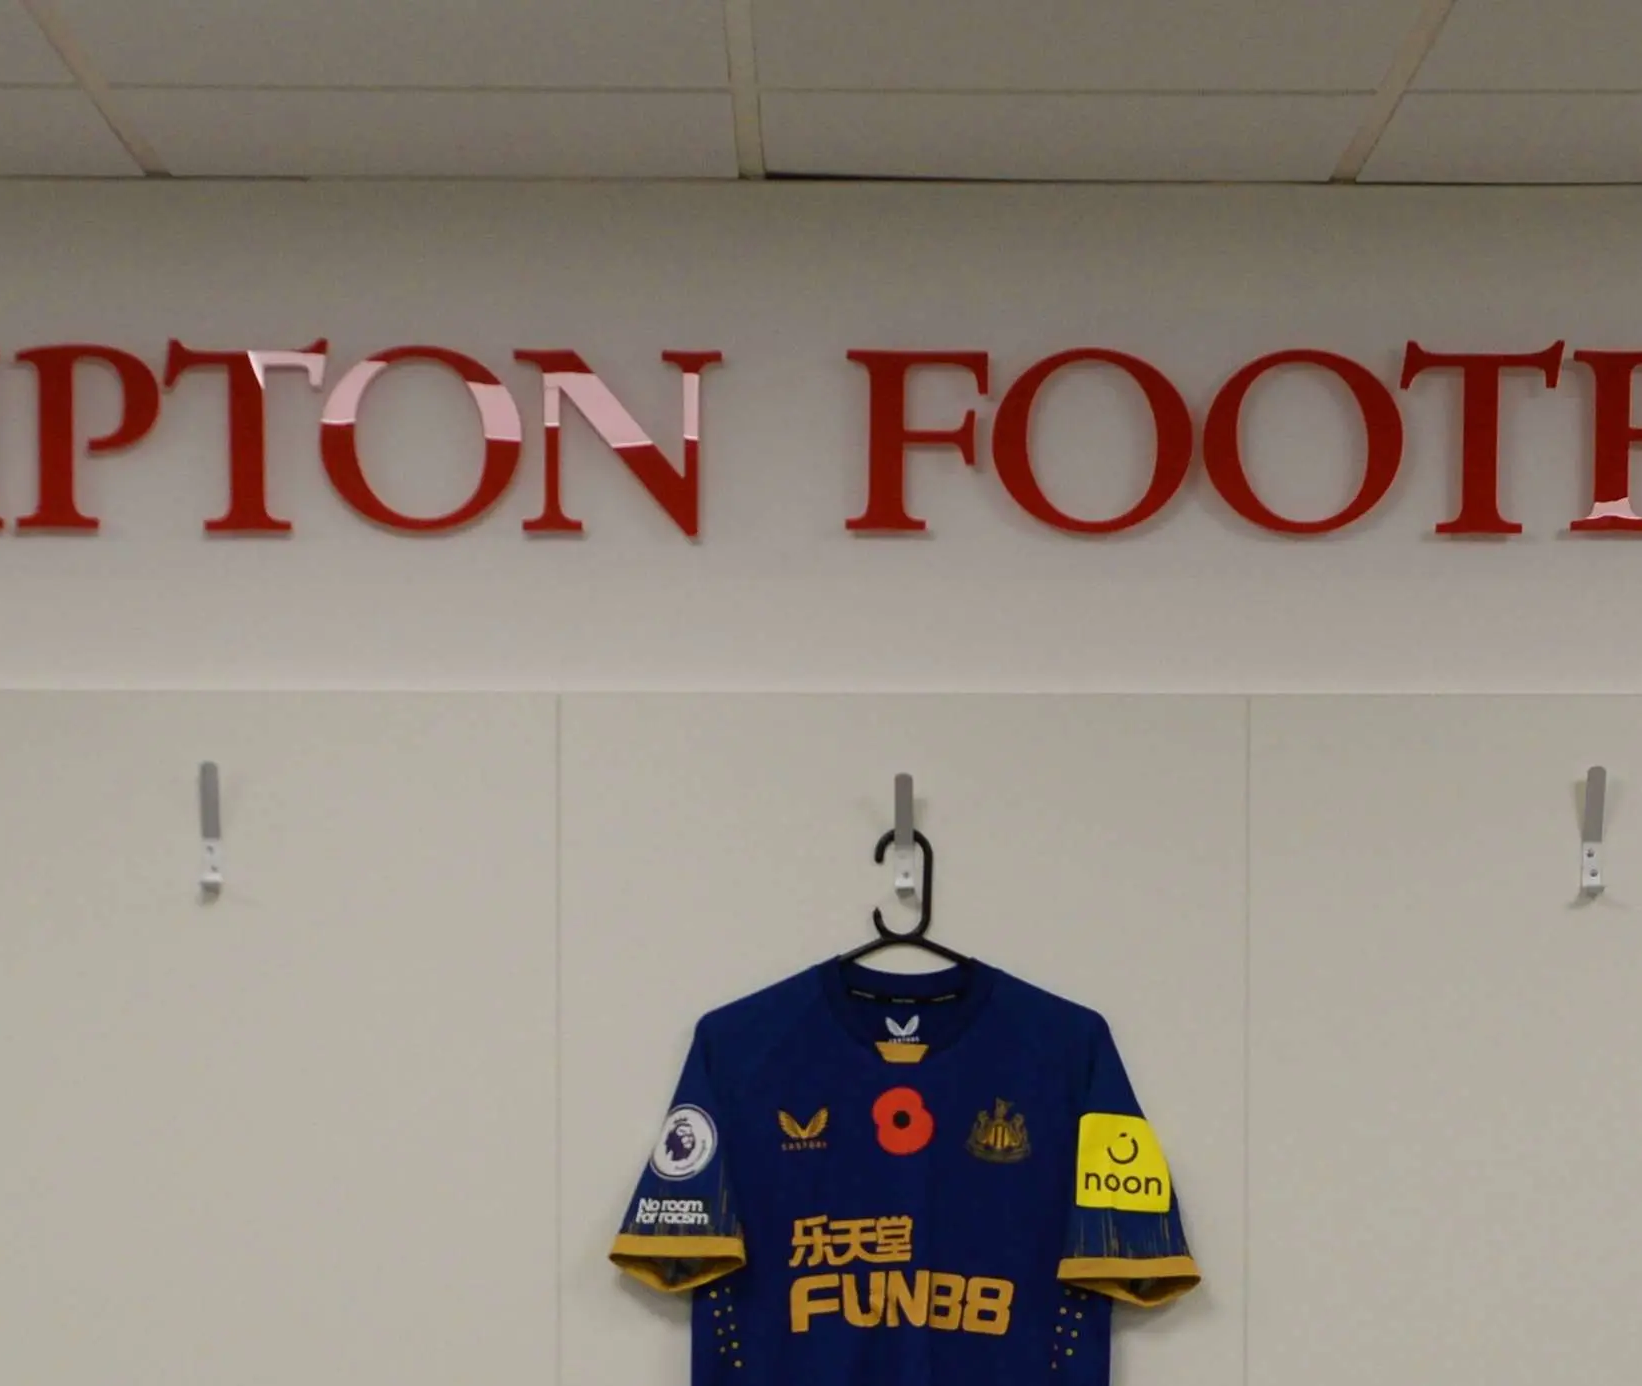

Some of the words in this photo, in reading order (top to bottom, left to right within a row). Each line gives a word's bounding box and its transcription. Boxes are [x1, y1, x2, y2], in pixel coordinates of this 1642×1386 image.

[1084, 1172, 1163, 1196] noon
[638, 1198, 660, 1212] No
[661, 1199, 704, 1212] room
[658, 1212, 709, 1225] racism
[788, 1215, 913, 1268] 乐天堂
[789, 1269, 1015, 1336] FUN88
